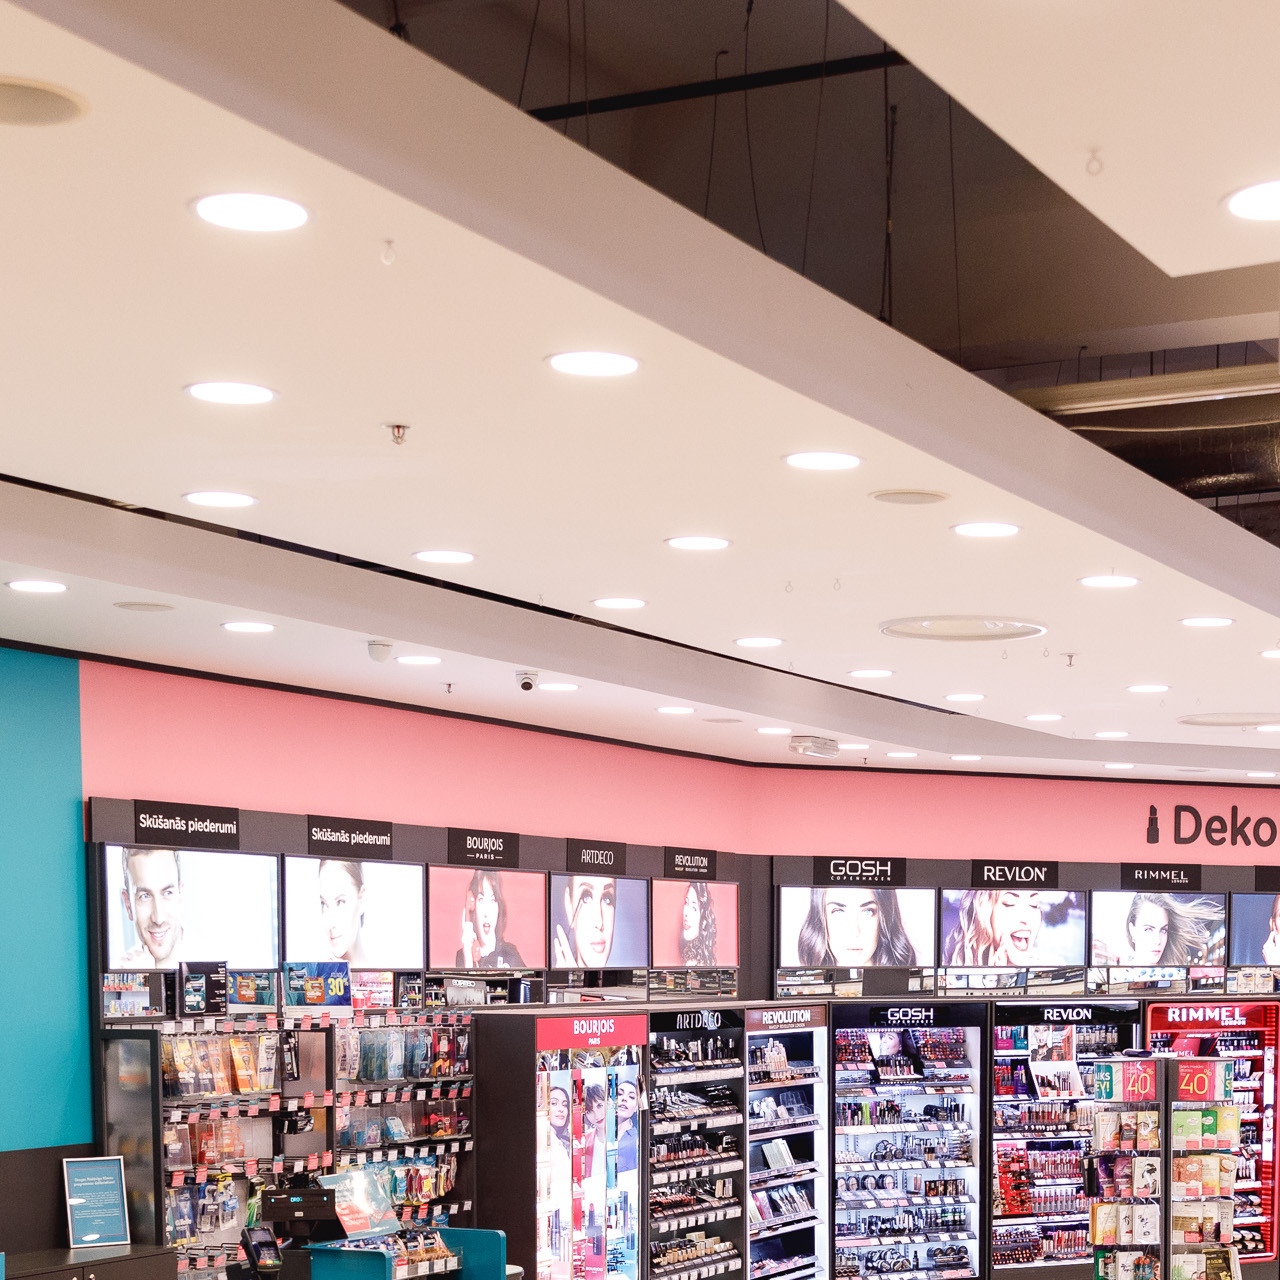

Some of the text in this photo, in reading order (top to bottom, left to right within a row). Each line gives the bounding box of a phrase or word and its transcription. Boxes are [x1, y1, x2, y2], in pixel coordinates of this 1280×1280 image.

[139, 813, 237, 834] Skūšanās piederumi
[311, 827, 390, 846] Skūšanās piederumi
[466, 836, 503, 852] BOURJOIS
[581, 849, 614, 865] ARTDECO
[675, 854, 707, 867] REVOLUTION
[830, 860, 891, 876] GOSH
[984, 866, 1046, 881] REVLON
[1135, 869, 1188, 880] RIMMEL
[762, 1009, 811, 1025] REVOLUTION
[887, 1007, 934, 1021] GOSH
[1044, 1008, 1092, 1021] REVLON
[1168, 1007, 1247, 1022] RIMMEL
[574, 1019, 615, 1036] BOURJOIS
[588, 1037, 601, 1045] PARIS
[1096, 1081, 1110, 1091] EV!
